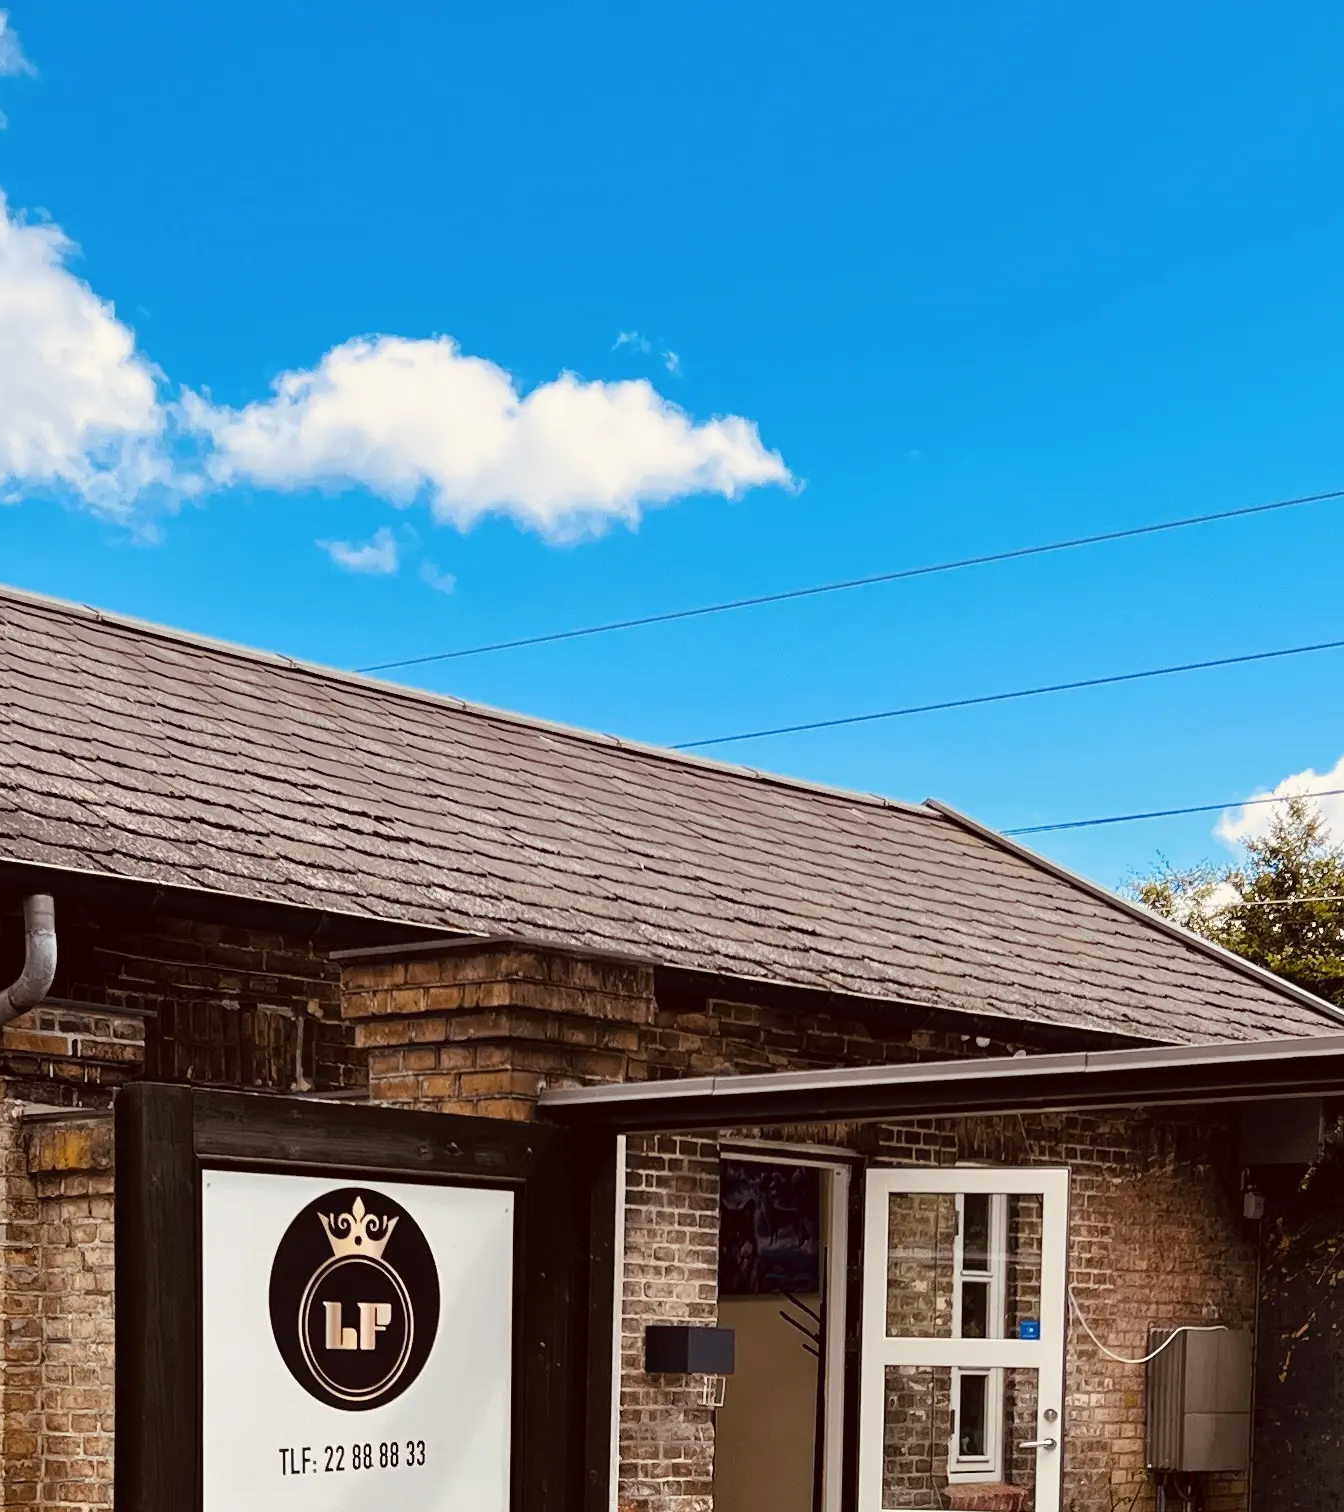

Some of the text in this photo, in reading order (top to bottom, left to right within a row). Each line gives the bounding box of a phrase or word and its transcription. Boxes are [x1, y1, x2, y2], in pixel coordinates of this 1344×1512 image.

[323, 1301, 392, 1350] LF
[279, 1440, 426, 1475] TLF: 22 88 88 33
